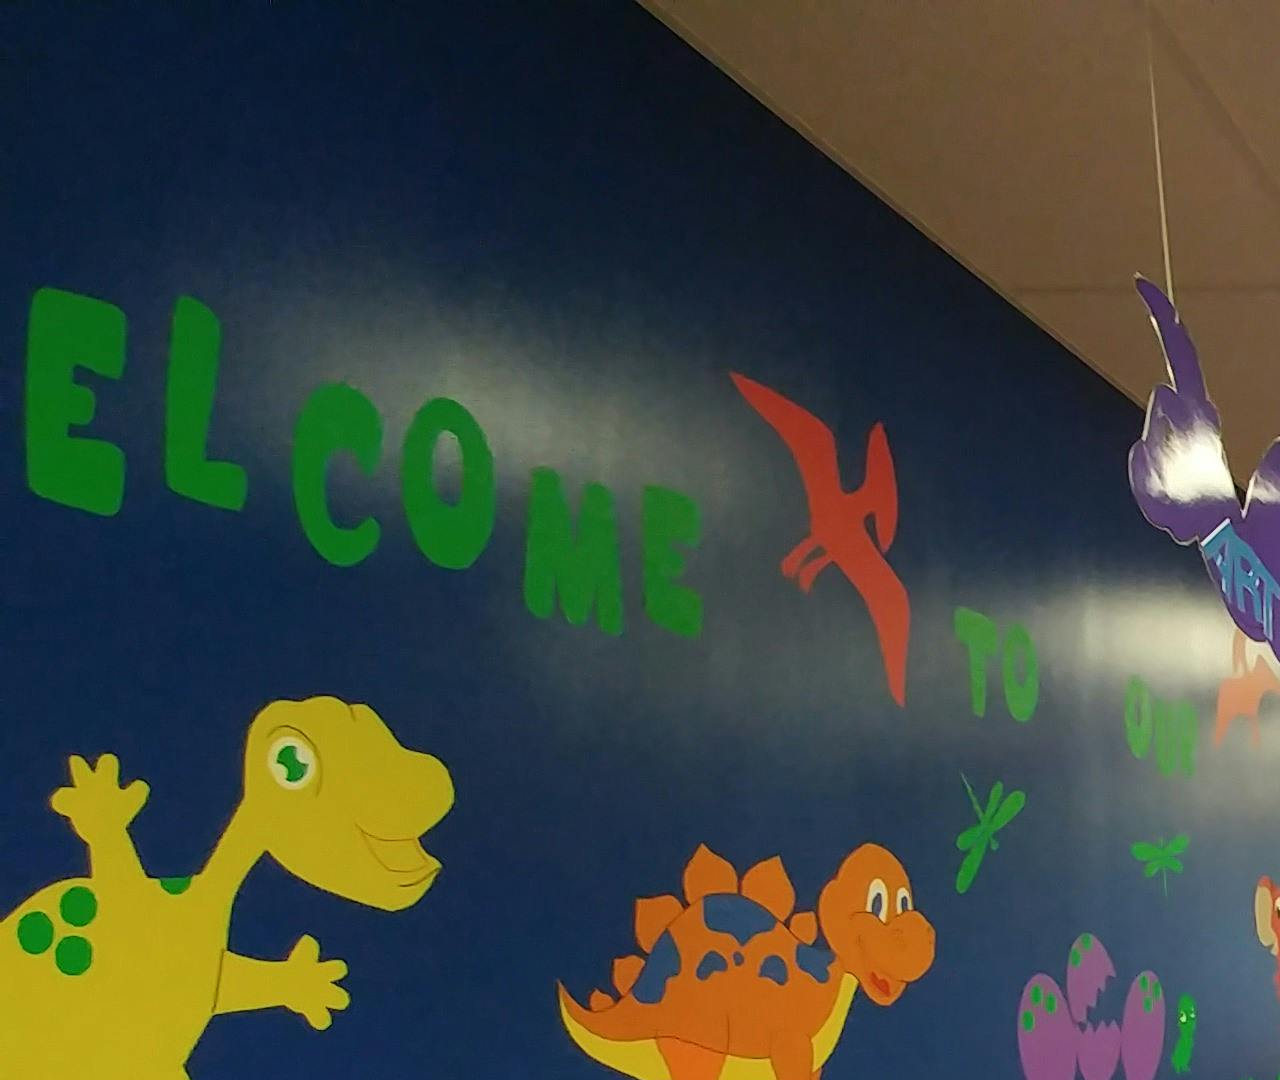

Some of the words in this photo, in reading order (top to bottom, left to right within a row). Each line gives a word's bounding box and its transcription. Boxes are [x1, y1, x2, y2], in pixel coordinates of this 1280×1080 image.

[1201, 519, 1280, 641] ART
[953, 606, 1039, 723] TO
[1124, 675, 1198, 778] OUR
